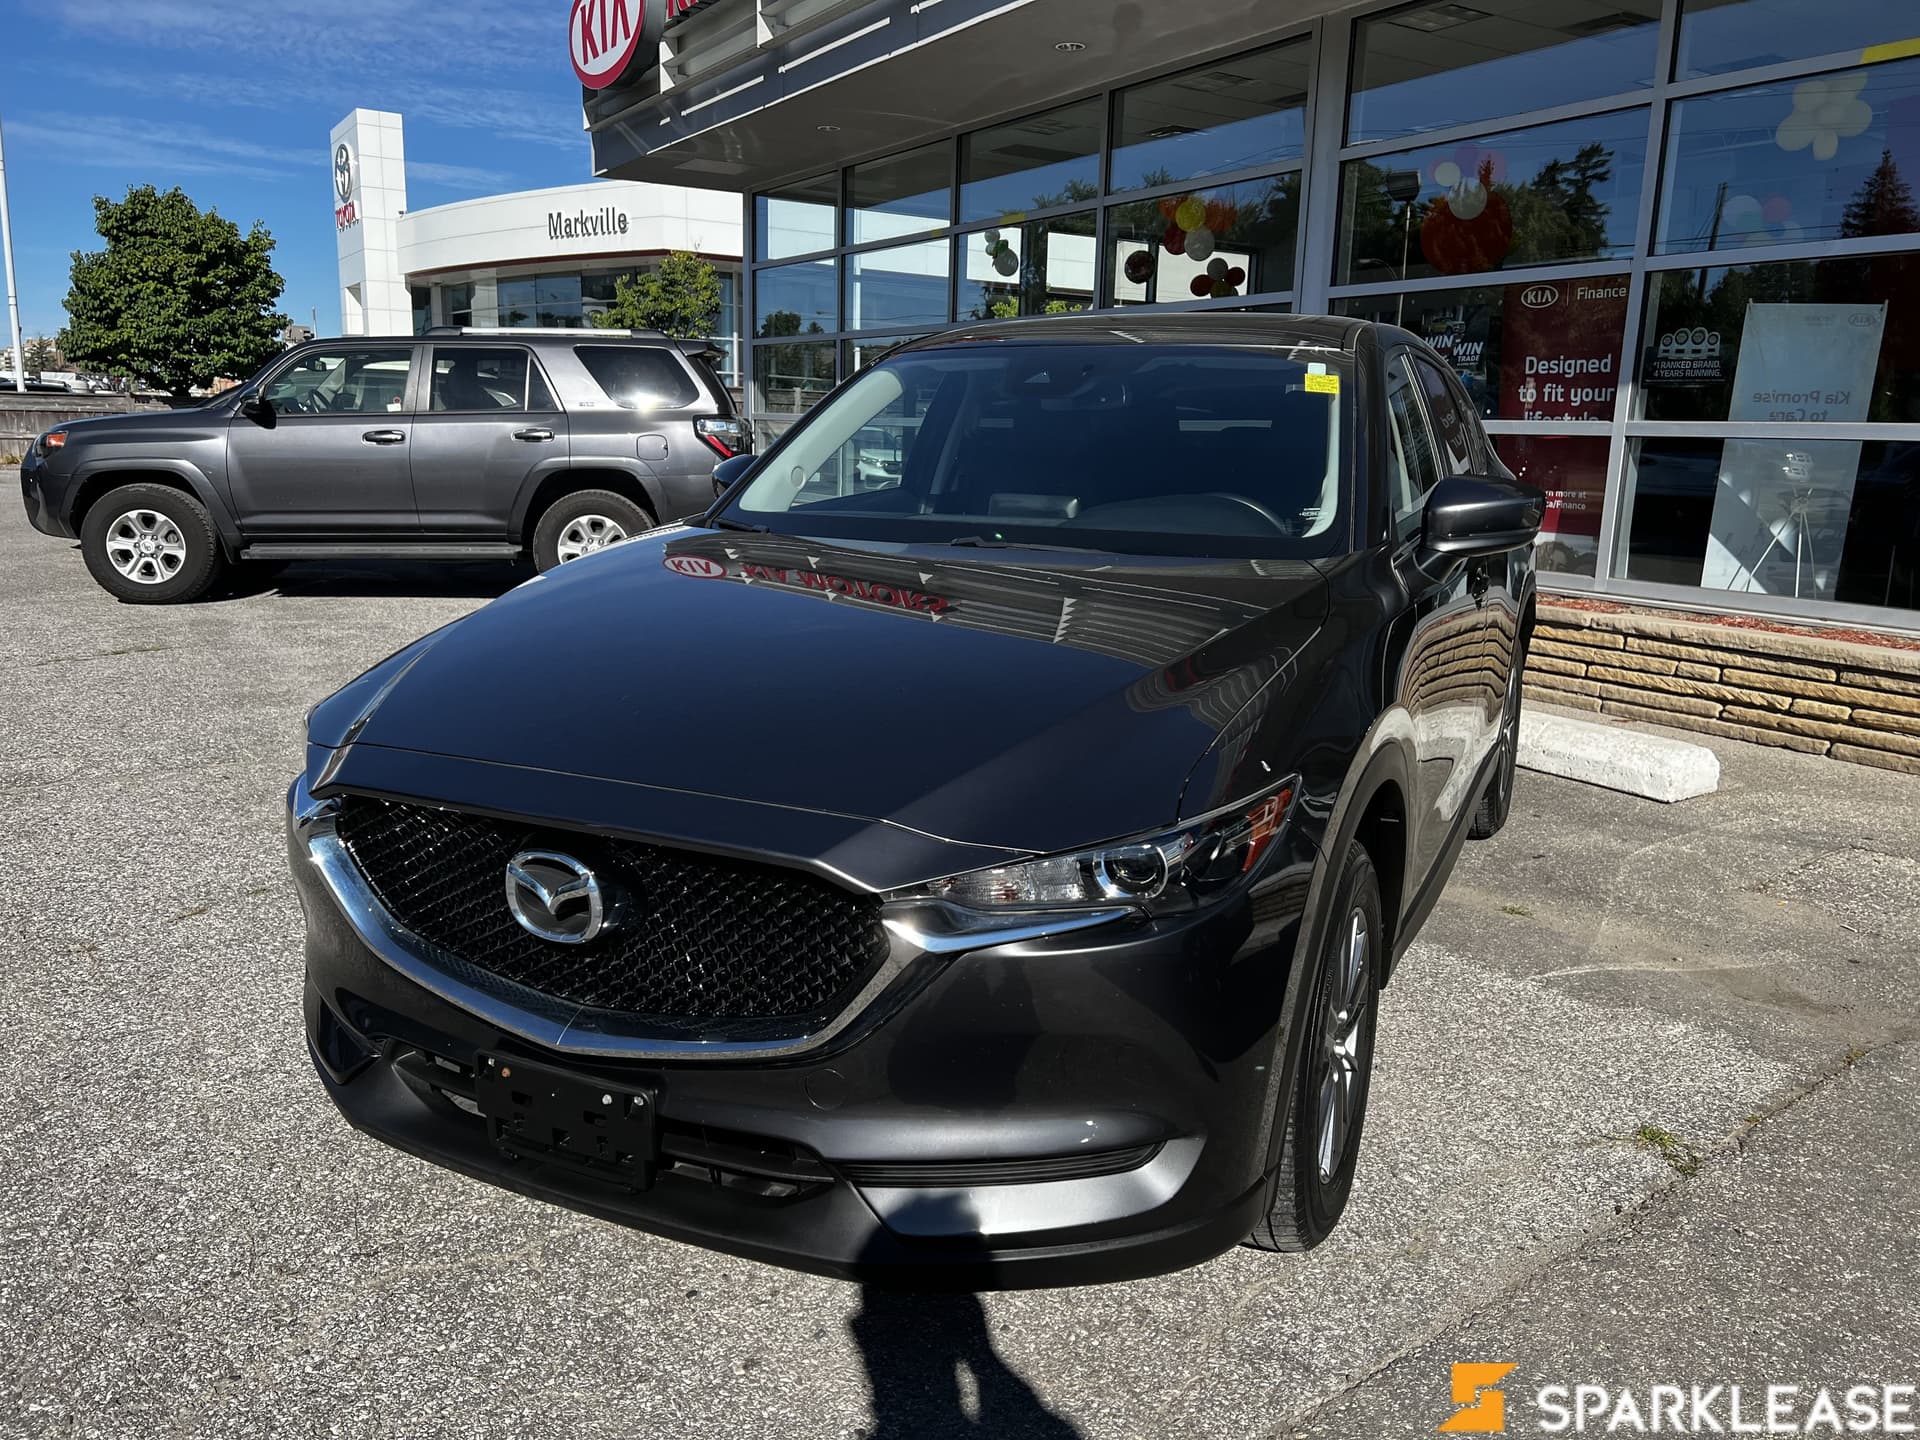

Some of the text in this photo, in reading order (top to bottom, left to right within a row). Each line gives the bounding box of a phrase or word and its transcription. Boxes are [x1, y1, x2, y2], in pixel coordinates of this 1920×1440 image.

[579, 0, 631, 66] KIA
[335, 200, 356, 229] TOYOTA
[548, 206, 629, 239] Markville
[1576, 286, 1628, 301] Finance
[1453, 341, 1484, 356] WIN
[1457, 354, 1480, 362] TRADE
[1524, 353, 1613, 378] Designed
[1660, 360, 1692, 369] RANKED
[1660, 369, 1684, 377] YEARS
[1518, 383, 1615, 407] to fit your
[1555, 490, 1577, 498] more
[1578, 490, 1587, 499] at
